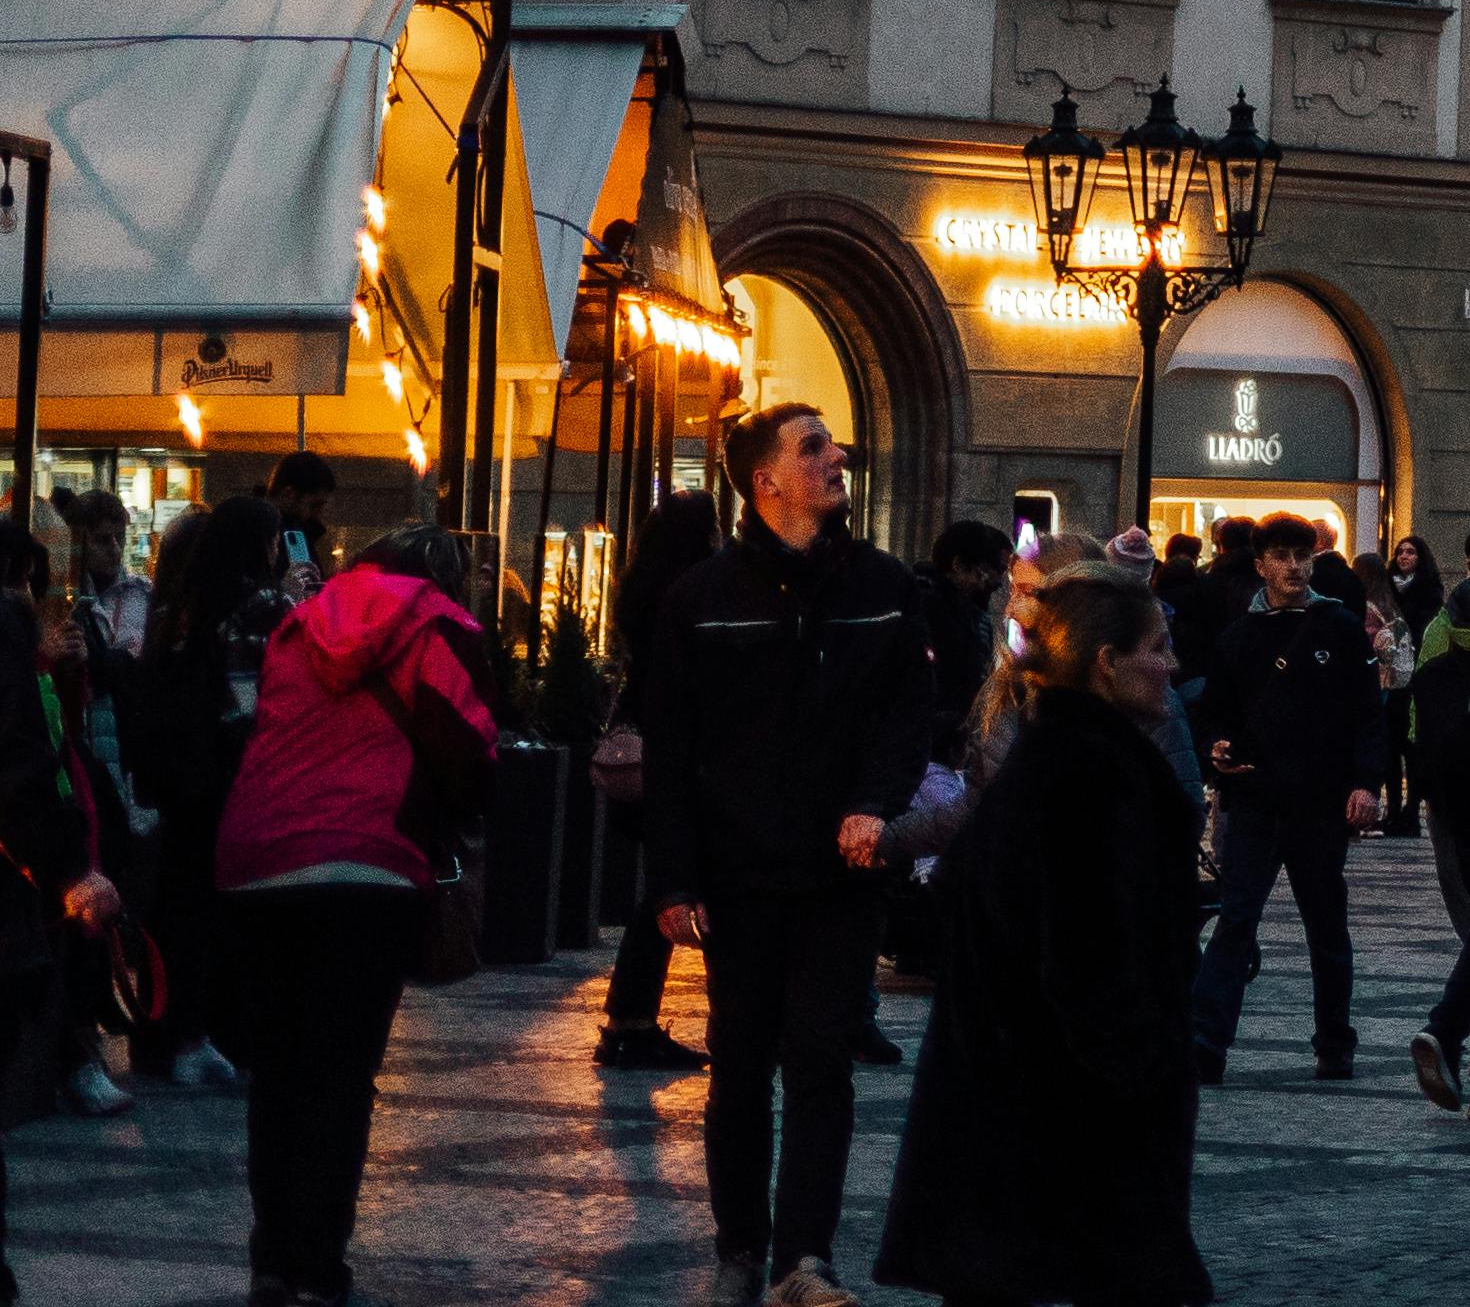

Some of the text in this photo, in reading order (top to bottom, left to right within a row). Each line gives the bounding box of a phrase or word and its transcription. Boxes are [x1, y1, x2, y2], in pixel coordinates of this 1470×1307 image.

[182, 357, 273, 388] Pilsner Urquell
[1208, 432, 1283, 466] LLADRÓ
